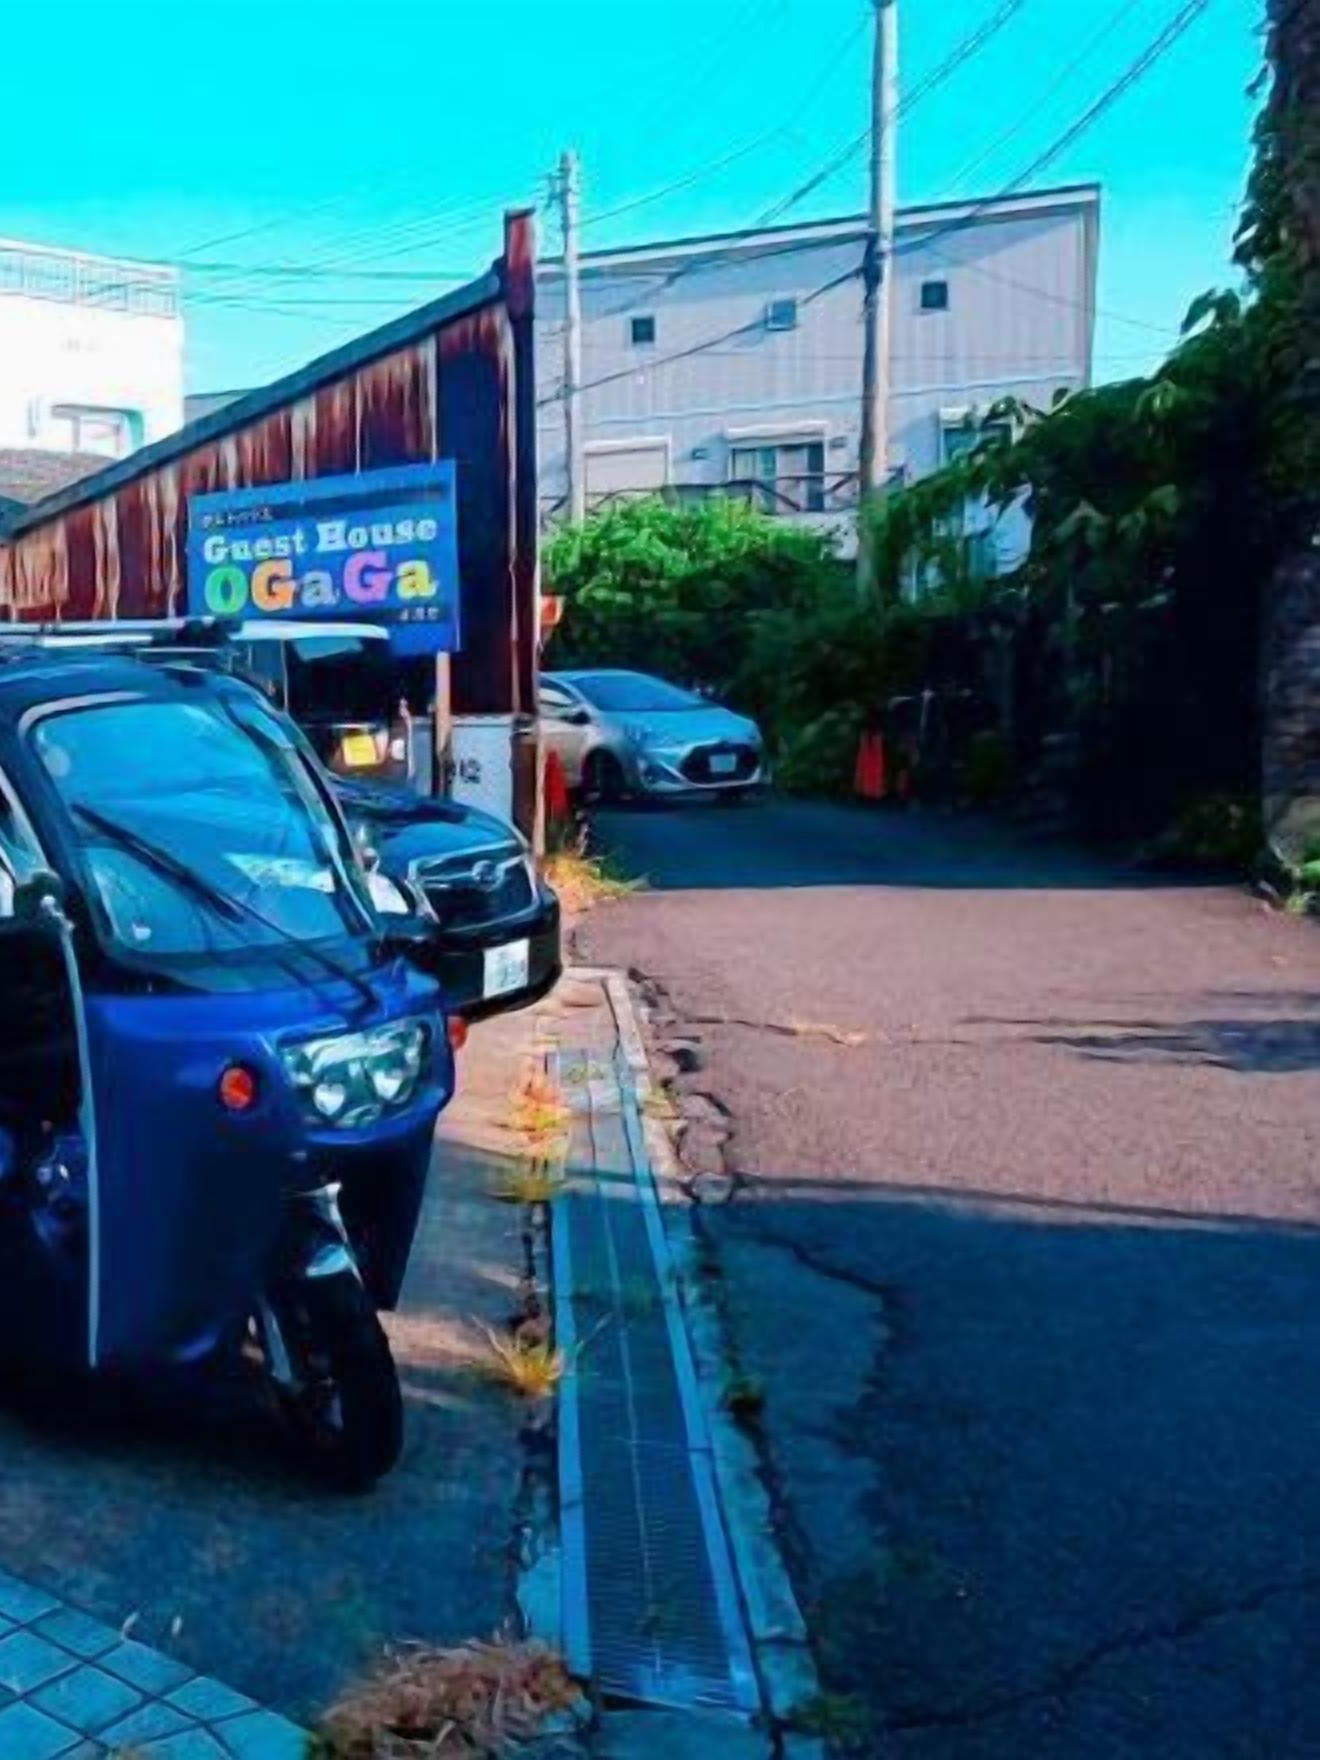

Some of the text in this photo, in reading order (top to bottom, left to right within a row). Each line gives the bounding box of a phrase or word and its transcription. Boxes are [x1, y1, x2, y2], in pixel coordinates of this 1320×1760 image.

[203, 518, 437, 564] Guest House
[204, 550, 439, 614] OGaGa
